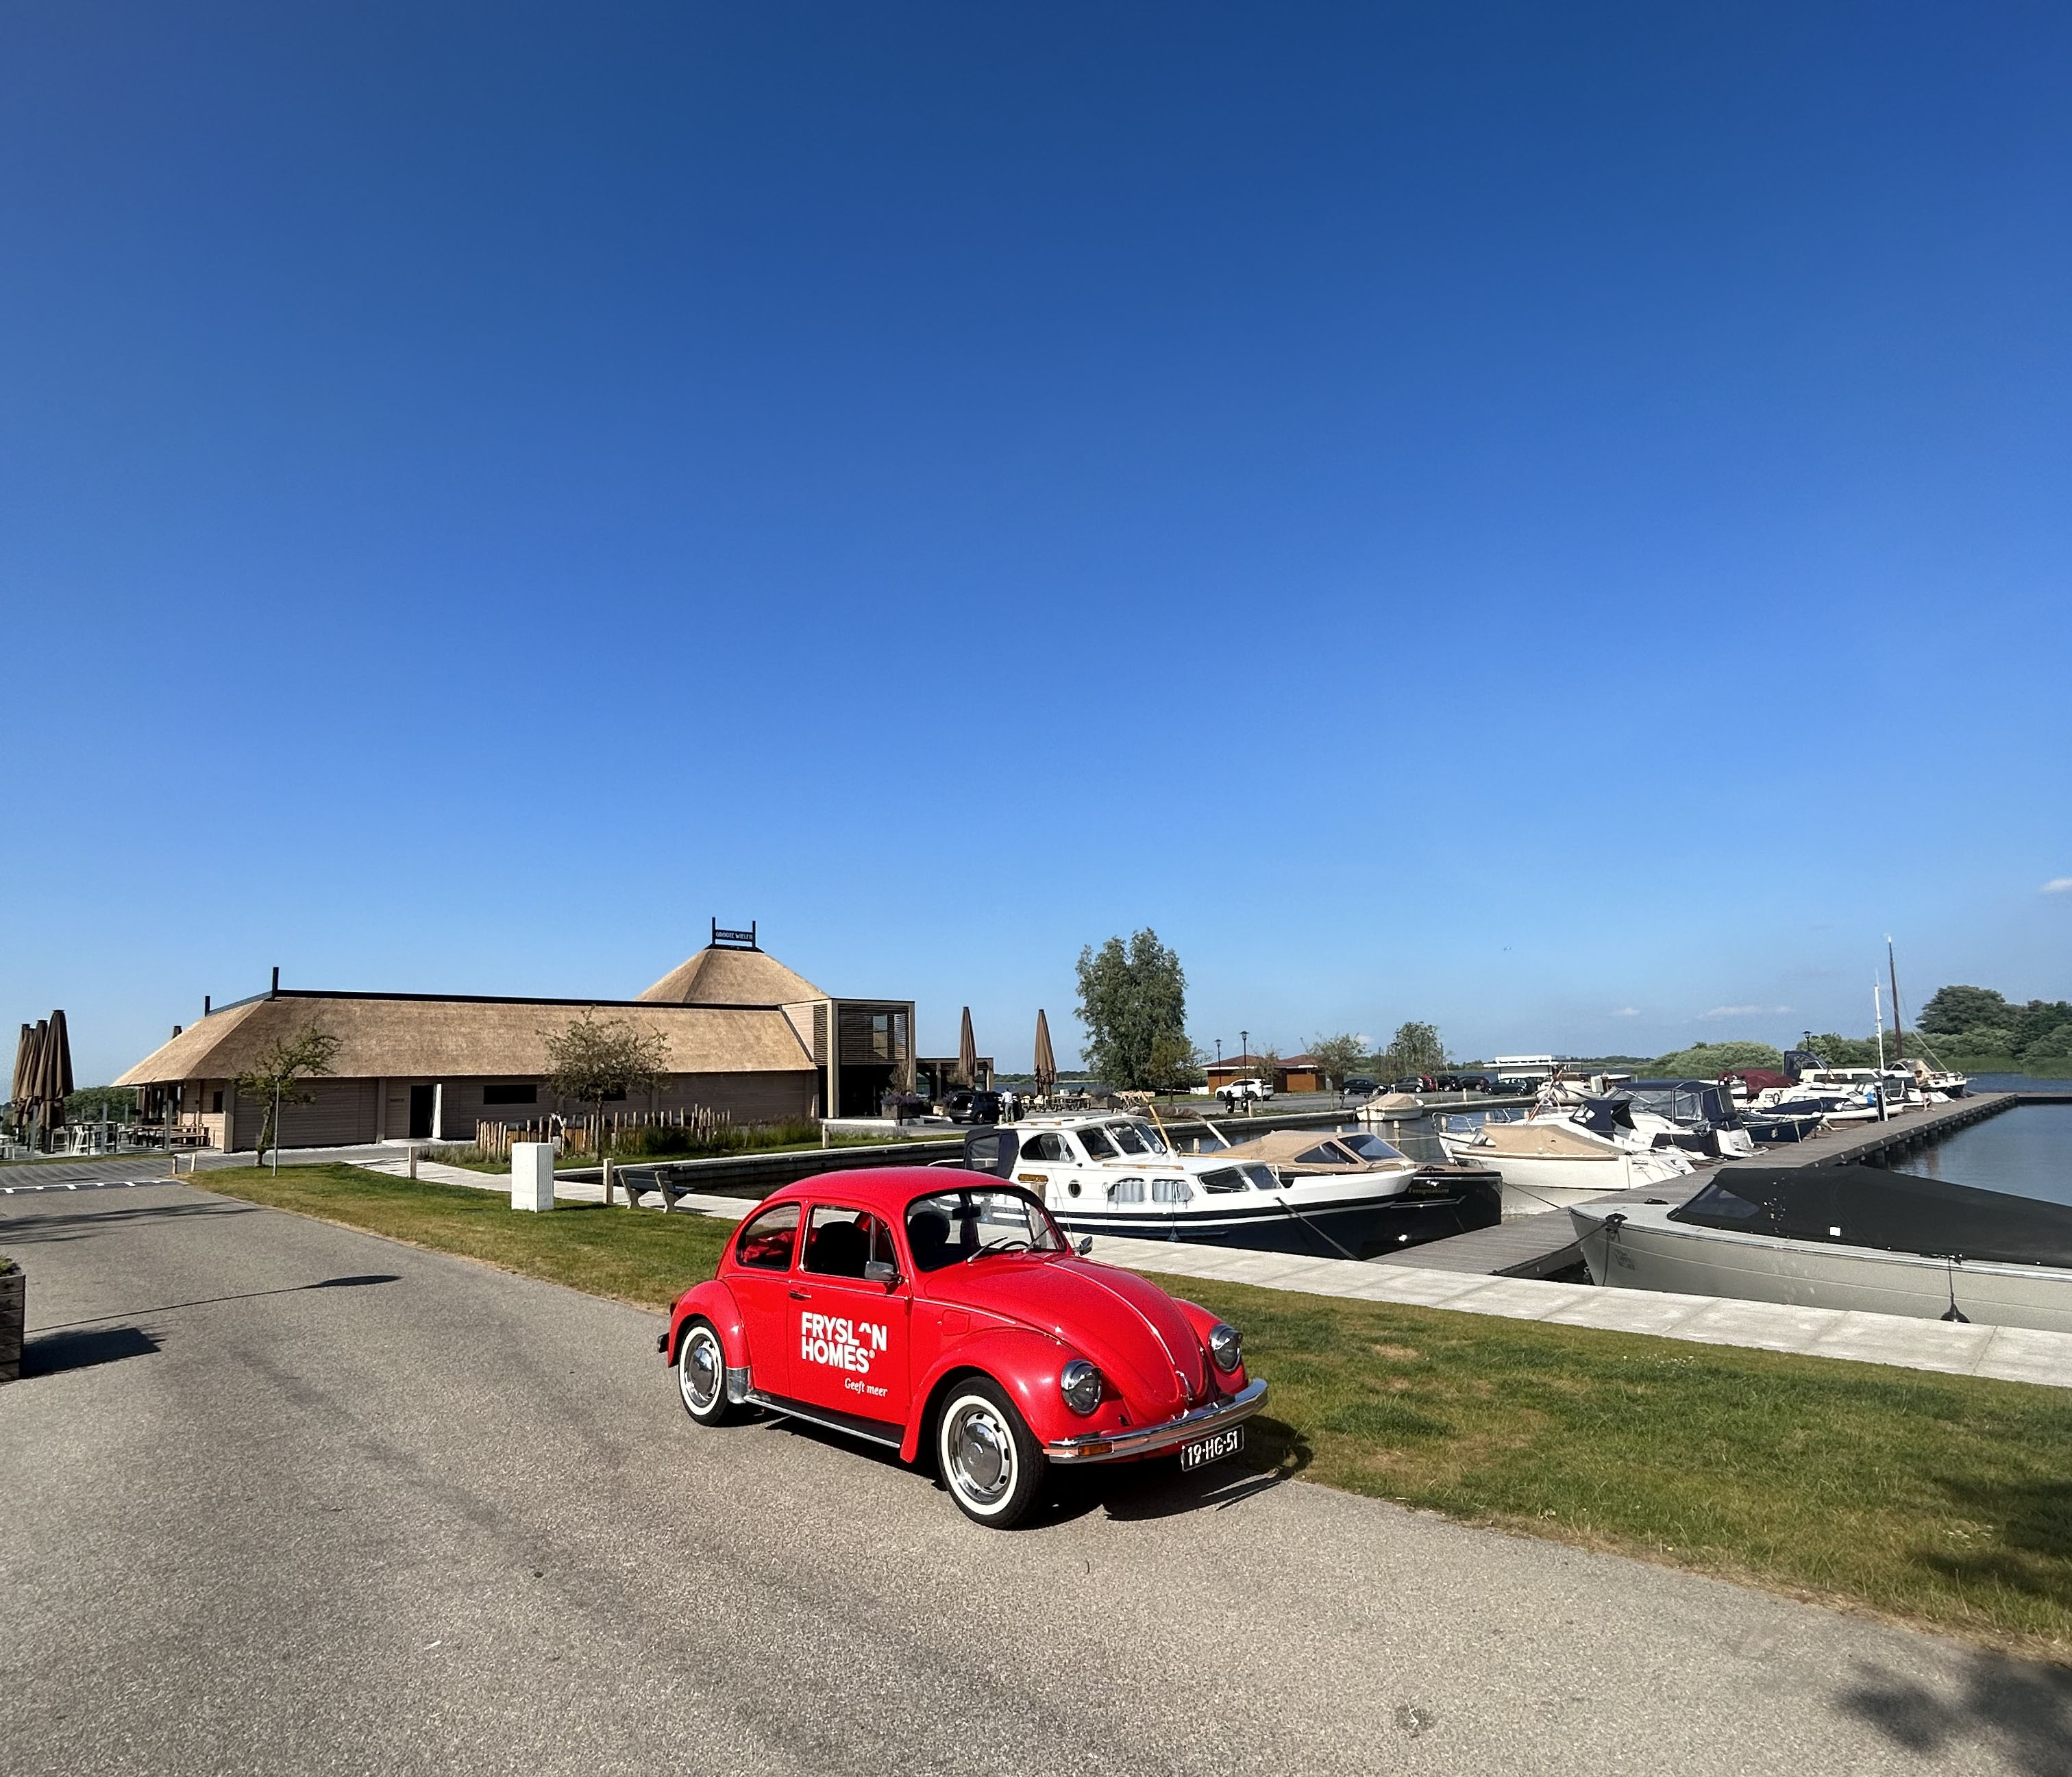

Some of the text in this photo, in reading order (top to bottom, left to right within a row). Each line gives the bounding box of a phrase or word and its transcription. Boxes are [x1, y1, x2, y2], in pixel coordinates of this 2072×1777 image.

[844, 1377, 888, 1397] Geeft meer
[1187, 1430, 1237, 1466] 19-HG-51
